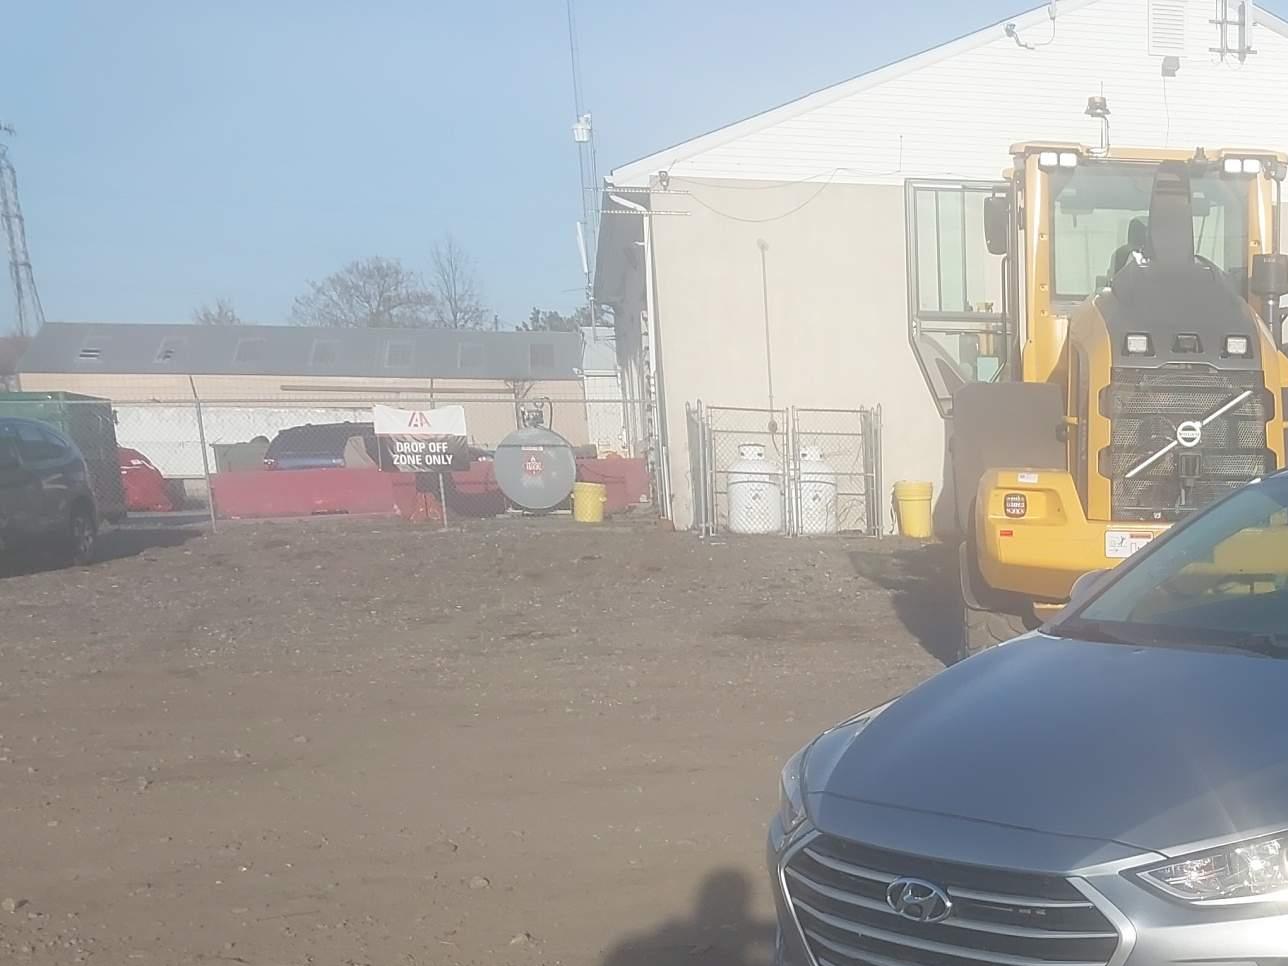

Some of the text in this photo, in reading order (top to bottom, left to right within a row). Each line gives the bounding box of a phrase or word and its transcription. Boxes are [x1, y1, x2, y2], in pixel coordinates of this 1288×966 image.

[396, 442, 448, 453] DROP OFF
[393, 454, 453, 465] ZONE ONLY
